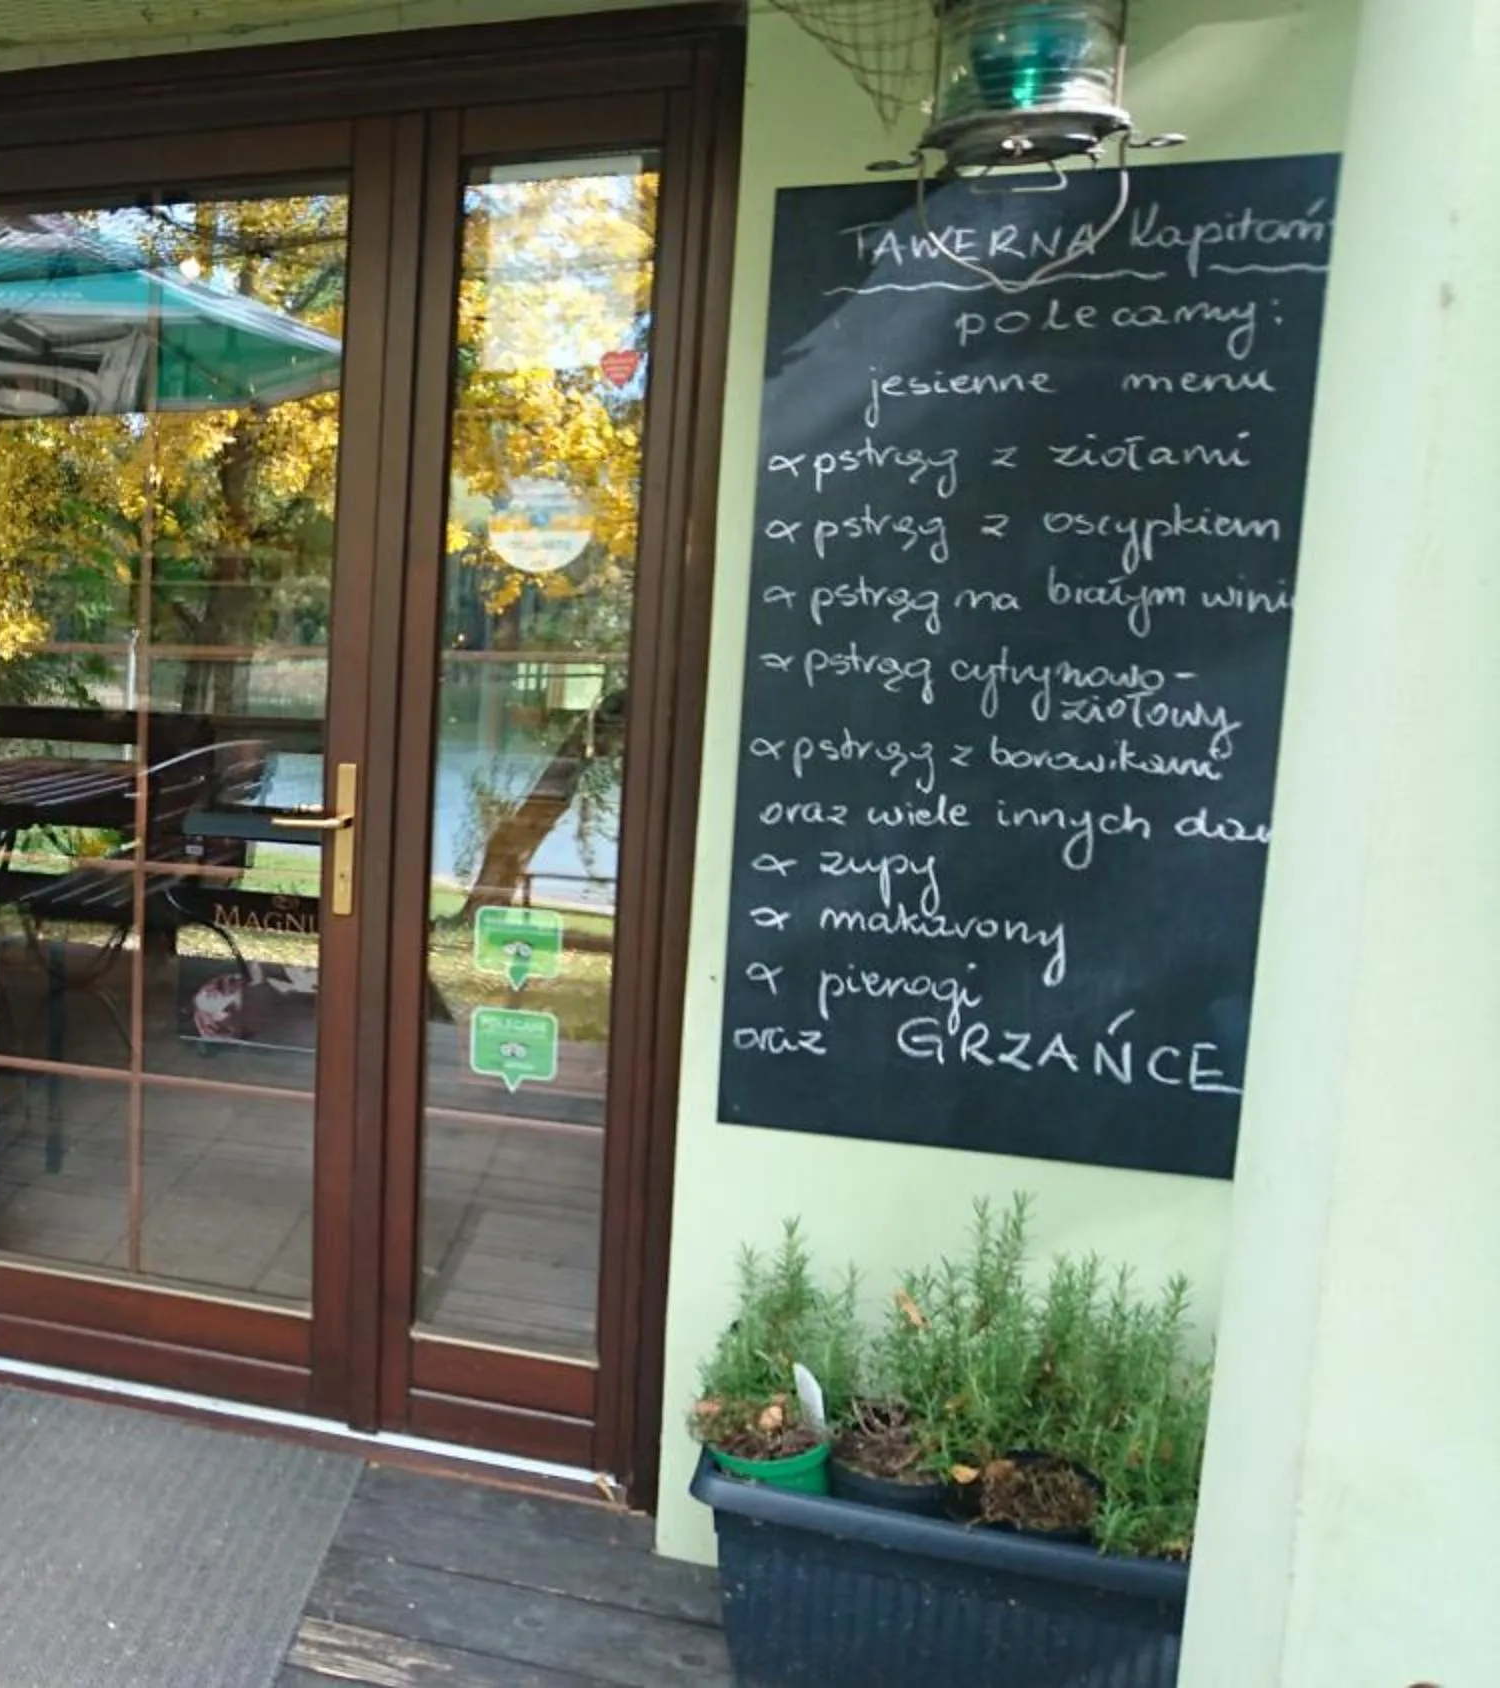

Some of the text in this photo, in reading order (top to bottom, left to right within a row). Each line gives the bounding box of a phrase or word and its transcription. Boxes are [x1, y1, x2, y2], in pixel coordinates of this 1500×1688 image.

[838, 222, 1098, 267] TAWERNA
[864, 367, 1277, 427] jesienne menu
[1049, 431, 1252, 473] ziołami
[953, 588, 1023, 614] na
[1047, 566, 1186, 639] białym
[1201, 575, 1294, 613] wini
[1060, 689, 1244, 760] ziołowy
[760, 802, 848, 828] oraz
[867, 795, 971, 829] wiele
[997, 800, 1151, 871] innych
[819, 849, 942, 914] zupy
[819, 903, 1066, 988] makarony
[817, 963, 983, 1034] pierogi
[732, 1009, 1243, 1096] oraz GRZAŃCE
